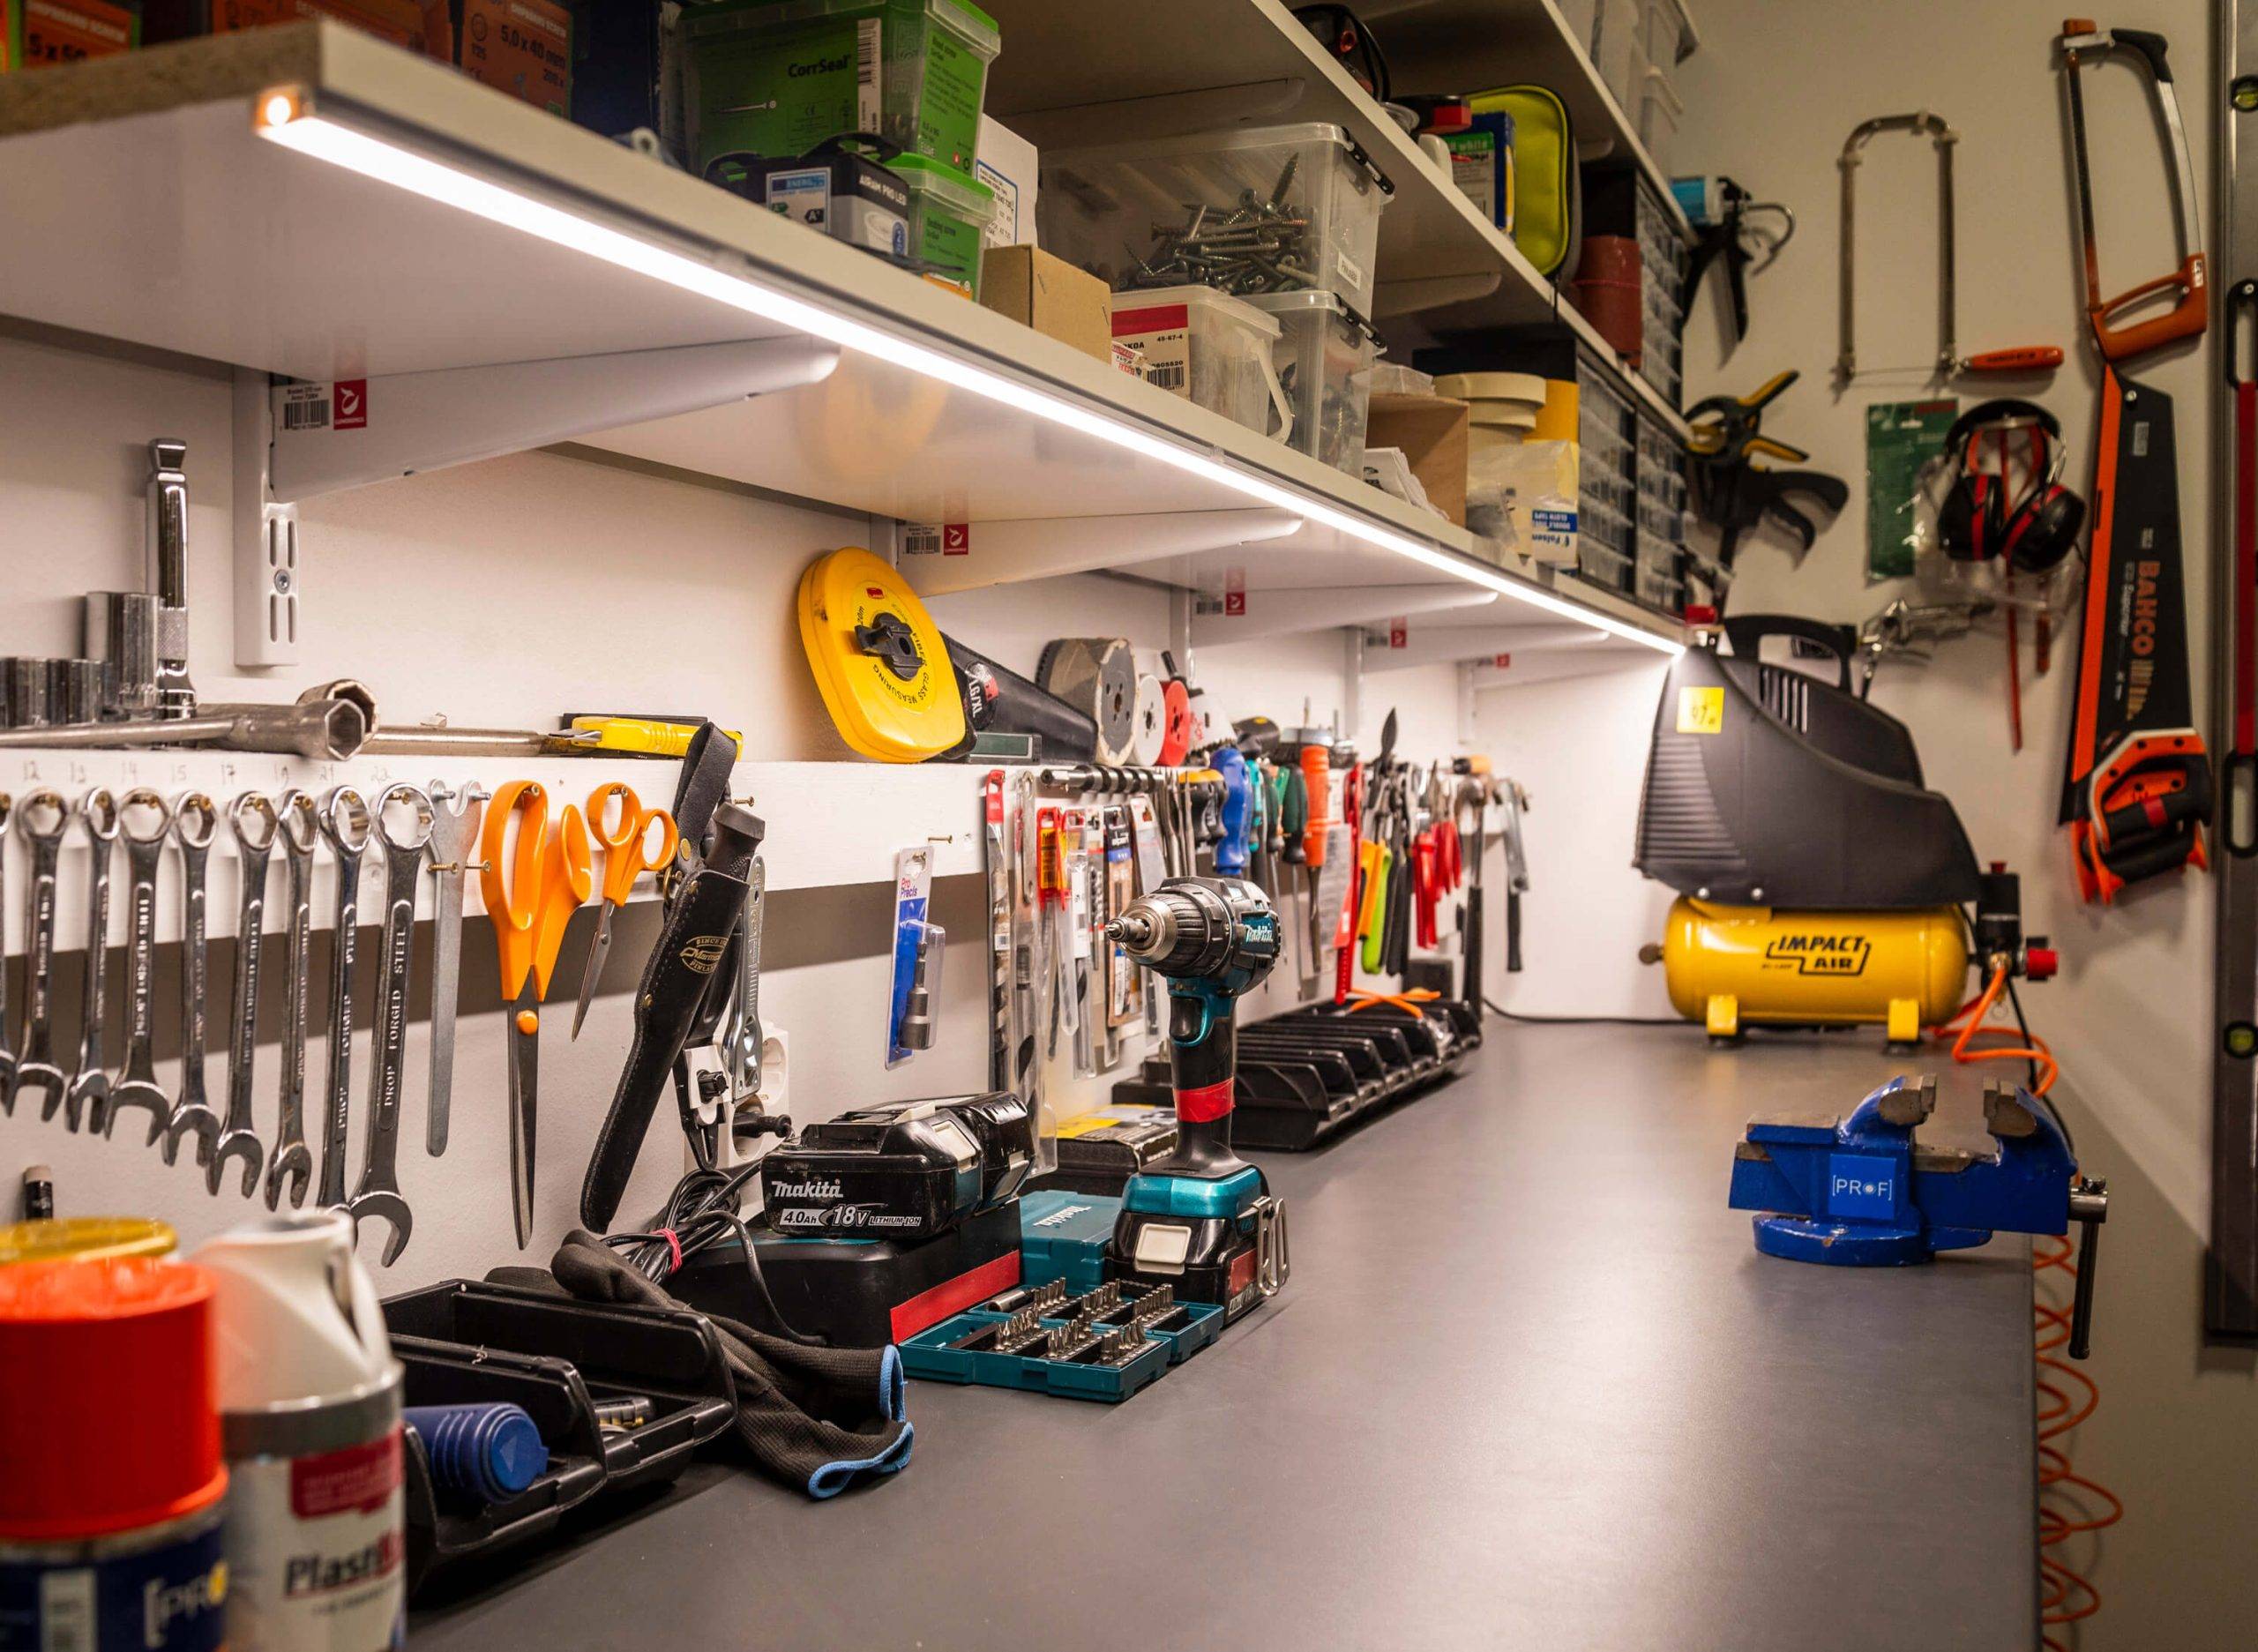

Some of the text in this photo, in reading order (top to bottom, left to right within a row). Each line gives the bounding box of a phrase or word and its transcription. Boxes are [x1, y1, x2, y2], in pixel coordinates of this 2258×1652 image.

[788, 54, 849, 78] CorrSeal
[2131, 560, 2161, 656] BAHCO
[872, 663, 918, 705] MEASURING
[916, 671, 930, 701] GLASS
[171, 765, 187, 783] 15
[221, 764, 235, 785] 17
[901, 877, 911, 889] Pro
[1777, 935, 1865, 952] IMPACT
[1813, 957, 1853, 969] AIR
[384, 926, 407, 1107] DROP FORGED STEEL
[771, 1179, 844, 1198] Makita
[783, 1204, 922, 1227] 4.0Ah 18V LITHIUM-ION
